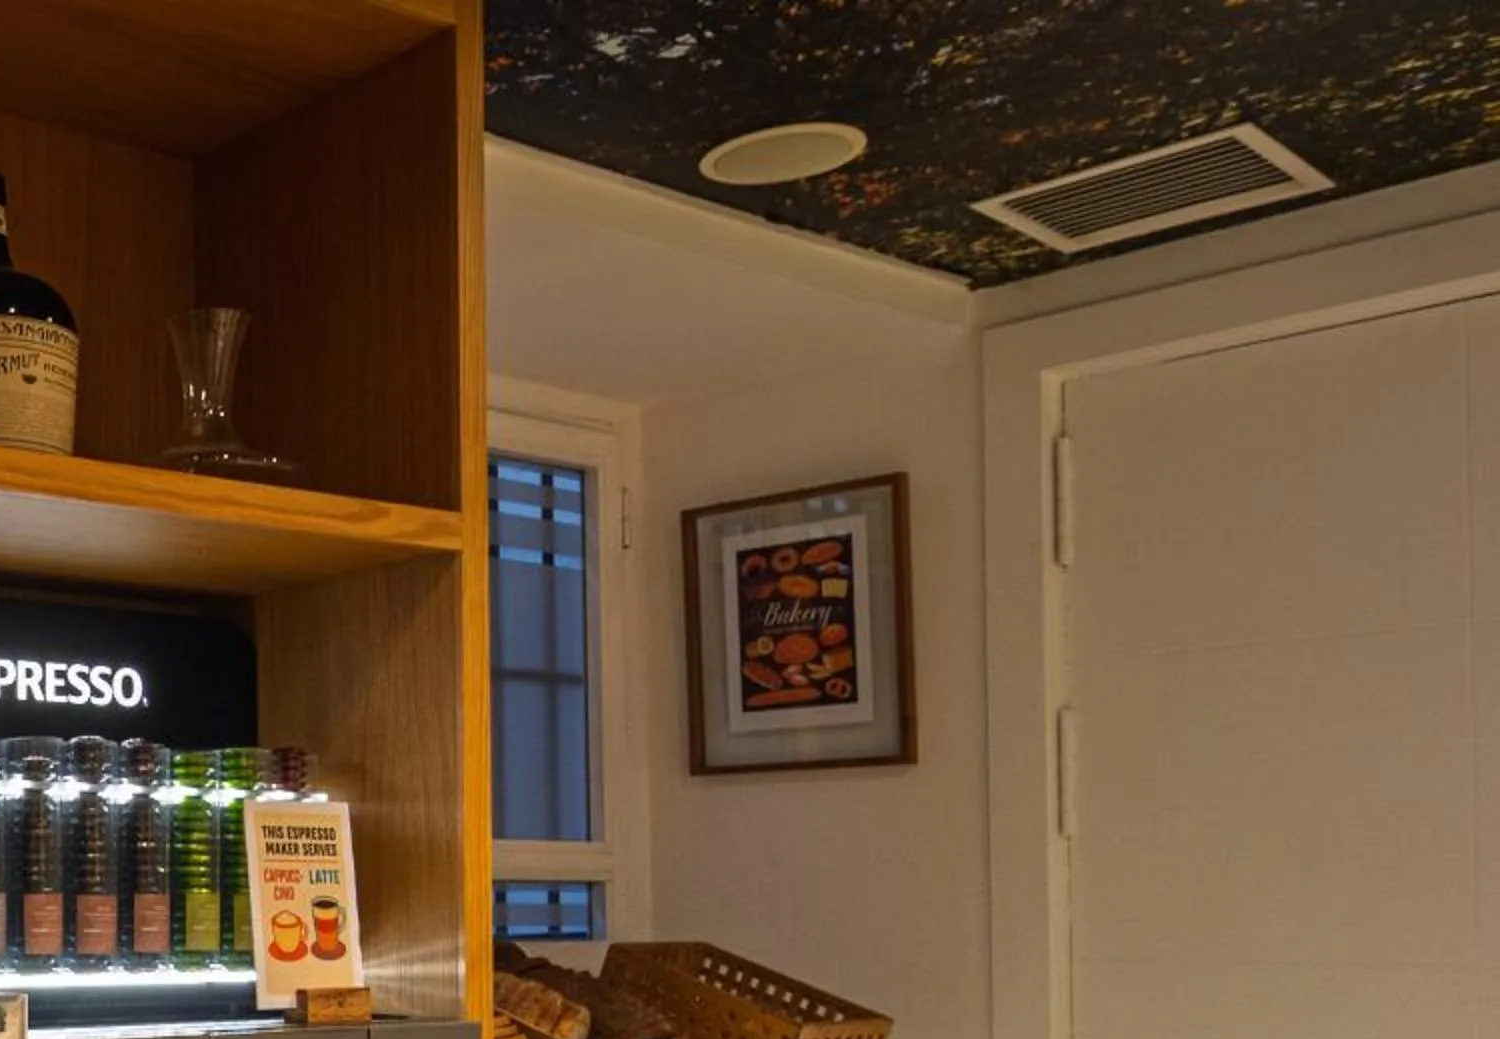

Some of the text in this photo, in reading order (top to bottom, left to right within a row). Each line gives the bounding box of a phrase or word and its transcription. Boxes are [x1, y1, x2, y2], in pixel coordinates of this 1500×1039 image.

[261, 825, 337, 841] THIS ESPRESSO
[265, 841, 337, 857] MAKER SERVES
[308, 869, 341, 885] LATTE
